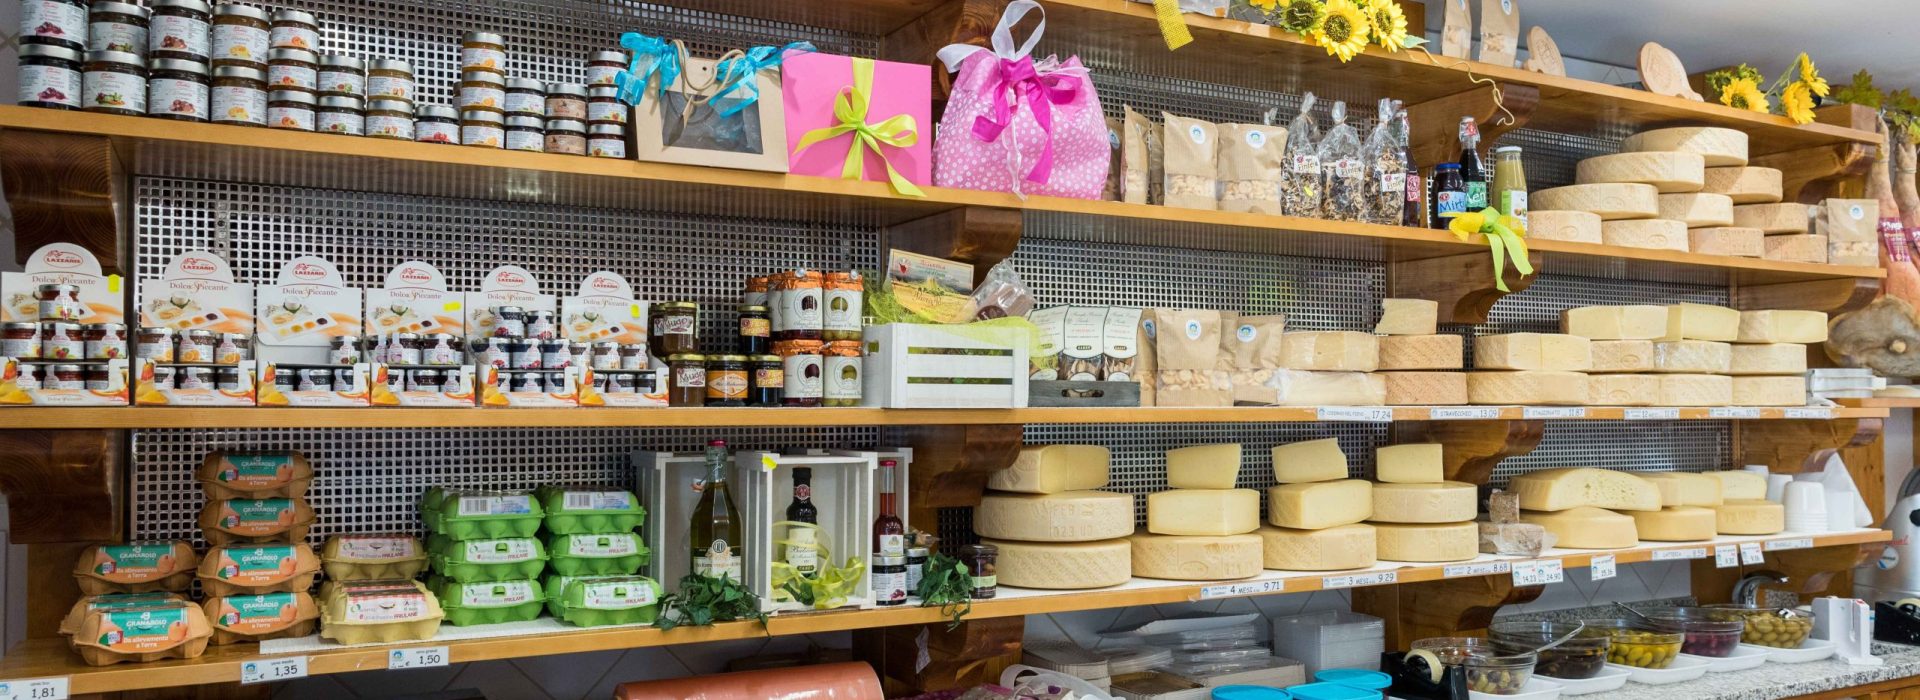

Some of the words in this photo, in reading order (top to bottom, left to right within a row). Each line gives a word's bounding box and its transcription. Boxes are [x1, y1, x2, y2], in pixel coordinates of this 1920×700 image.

[1349, 576, 1353, 585] 3
[1231, 585, 1236, 594] 4
[419, 654, 441, 666] 1,50
[275, 664, 298, 677] 1,35
[32, 687, 55, 699] 1,81
